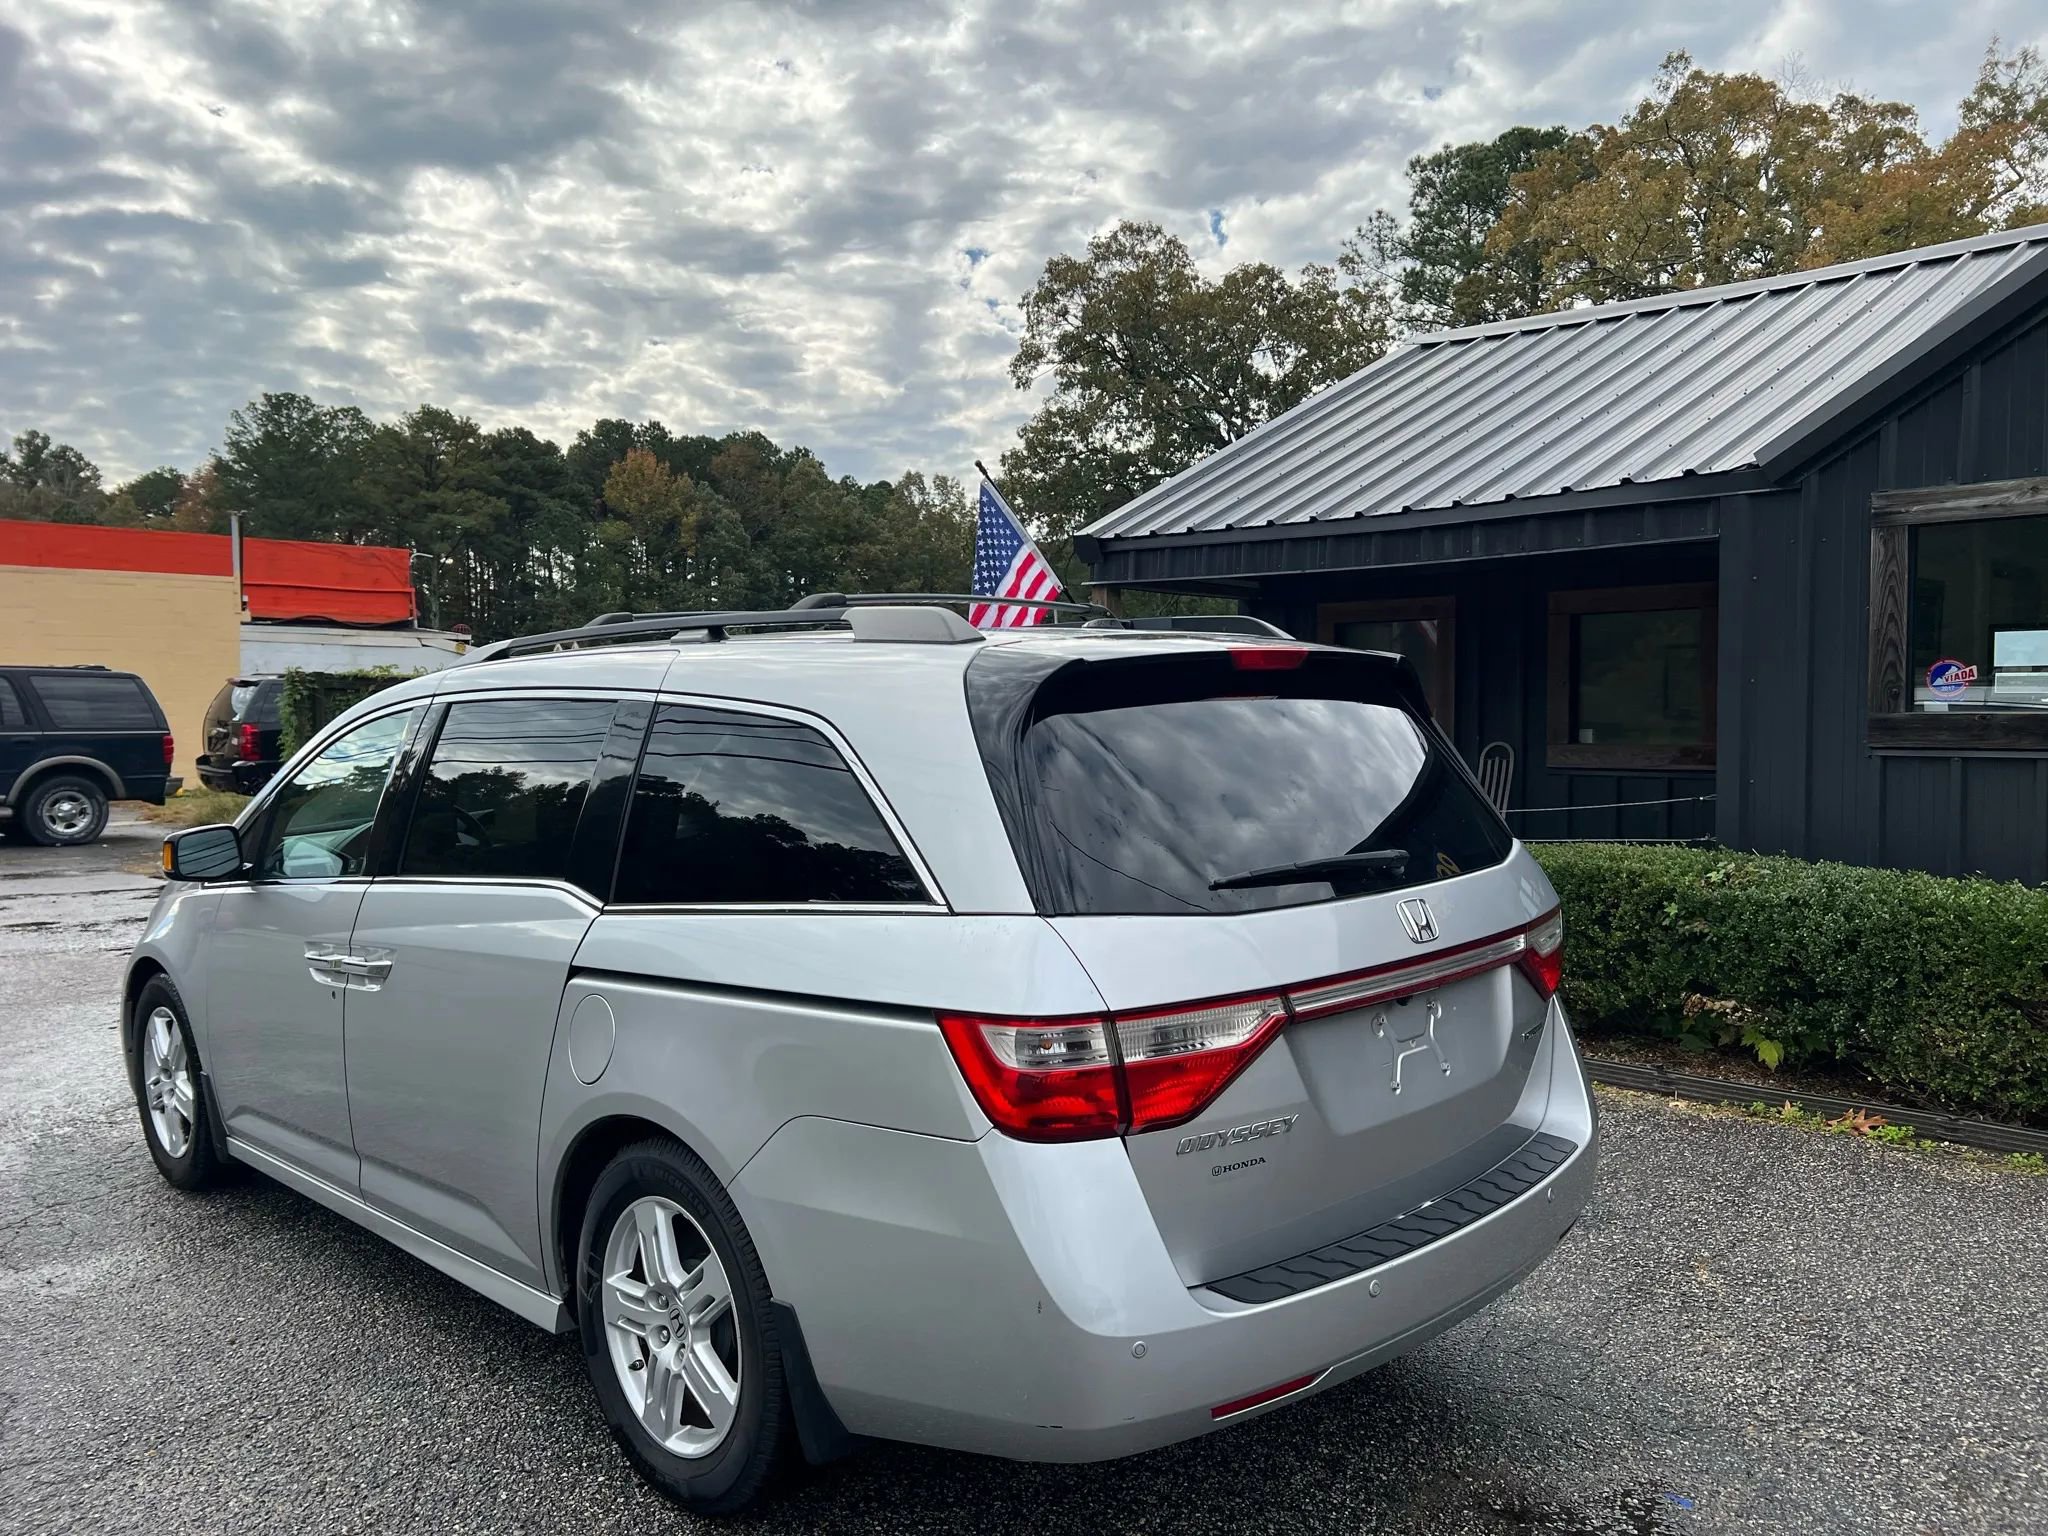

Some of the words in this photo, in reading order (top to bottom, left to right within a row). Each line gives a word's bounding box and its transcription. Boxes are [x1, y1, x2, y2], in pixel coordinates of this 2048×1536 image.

[1944, 668, 1975, 683] VIADA
[1176, 1114, 1299, 1155] ODYSSEY
[1223, 1156, 1267, 1173] HONDA
